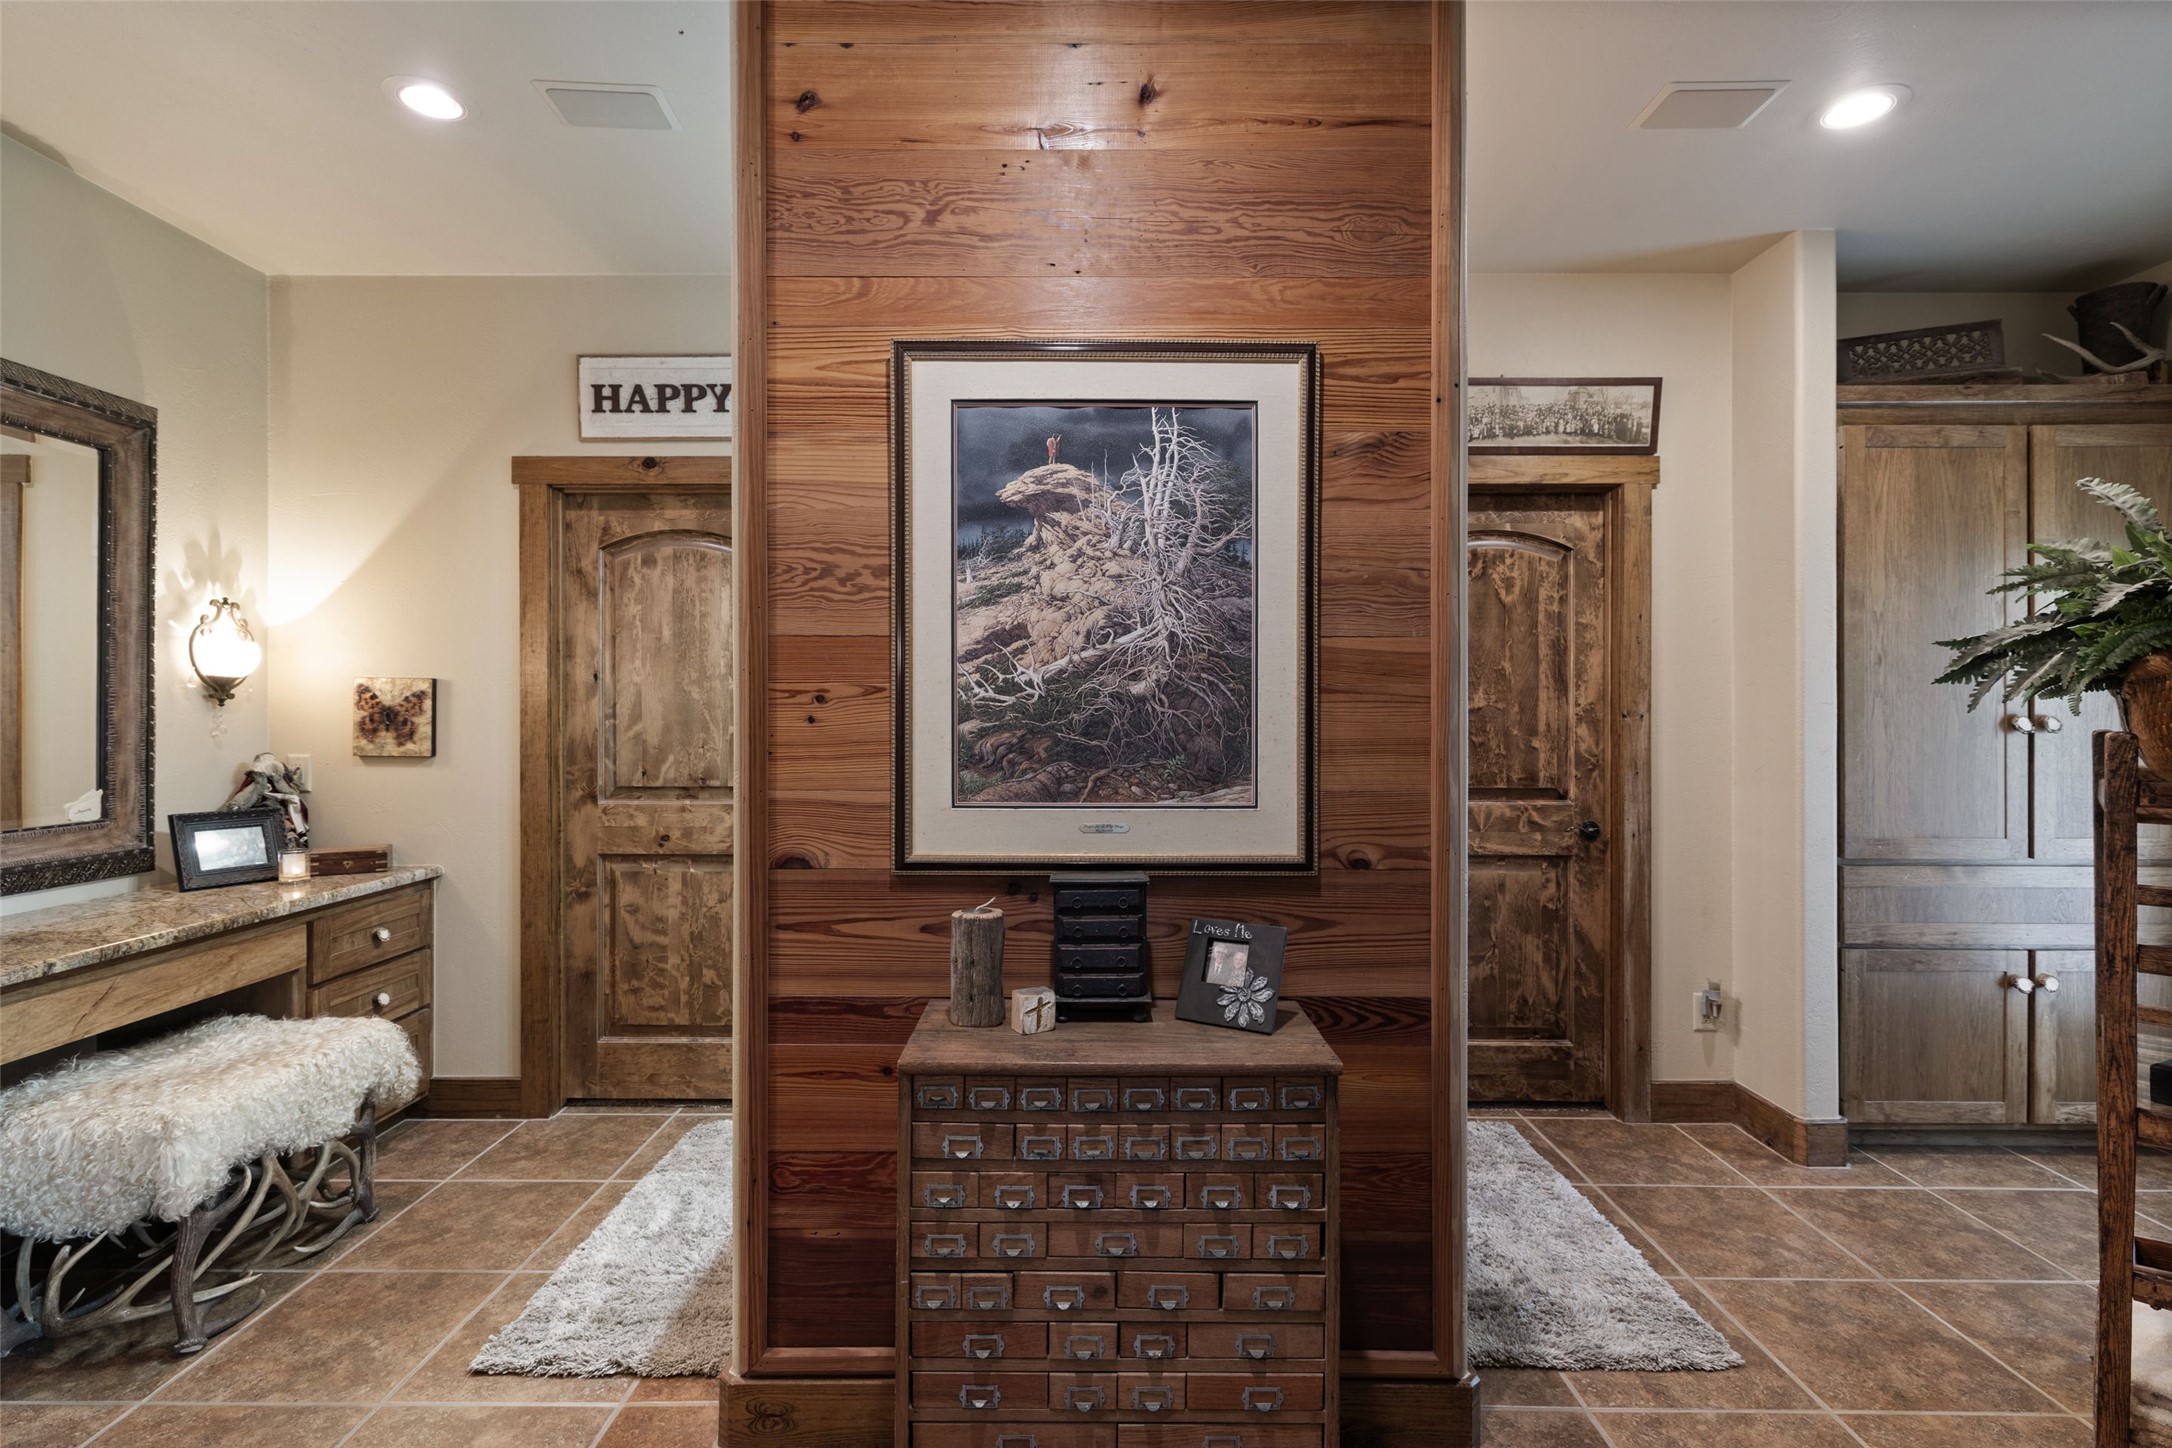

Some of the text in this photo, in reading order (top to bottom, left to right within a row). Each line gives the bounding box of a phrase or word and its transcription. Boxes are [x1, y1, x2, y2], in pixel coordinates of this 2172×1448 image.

[590, 383, 732, 413] HAPPY
[1193, 919, 1253, 939] Loves Me
